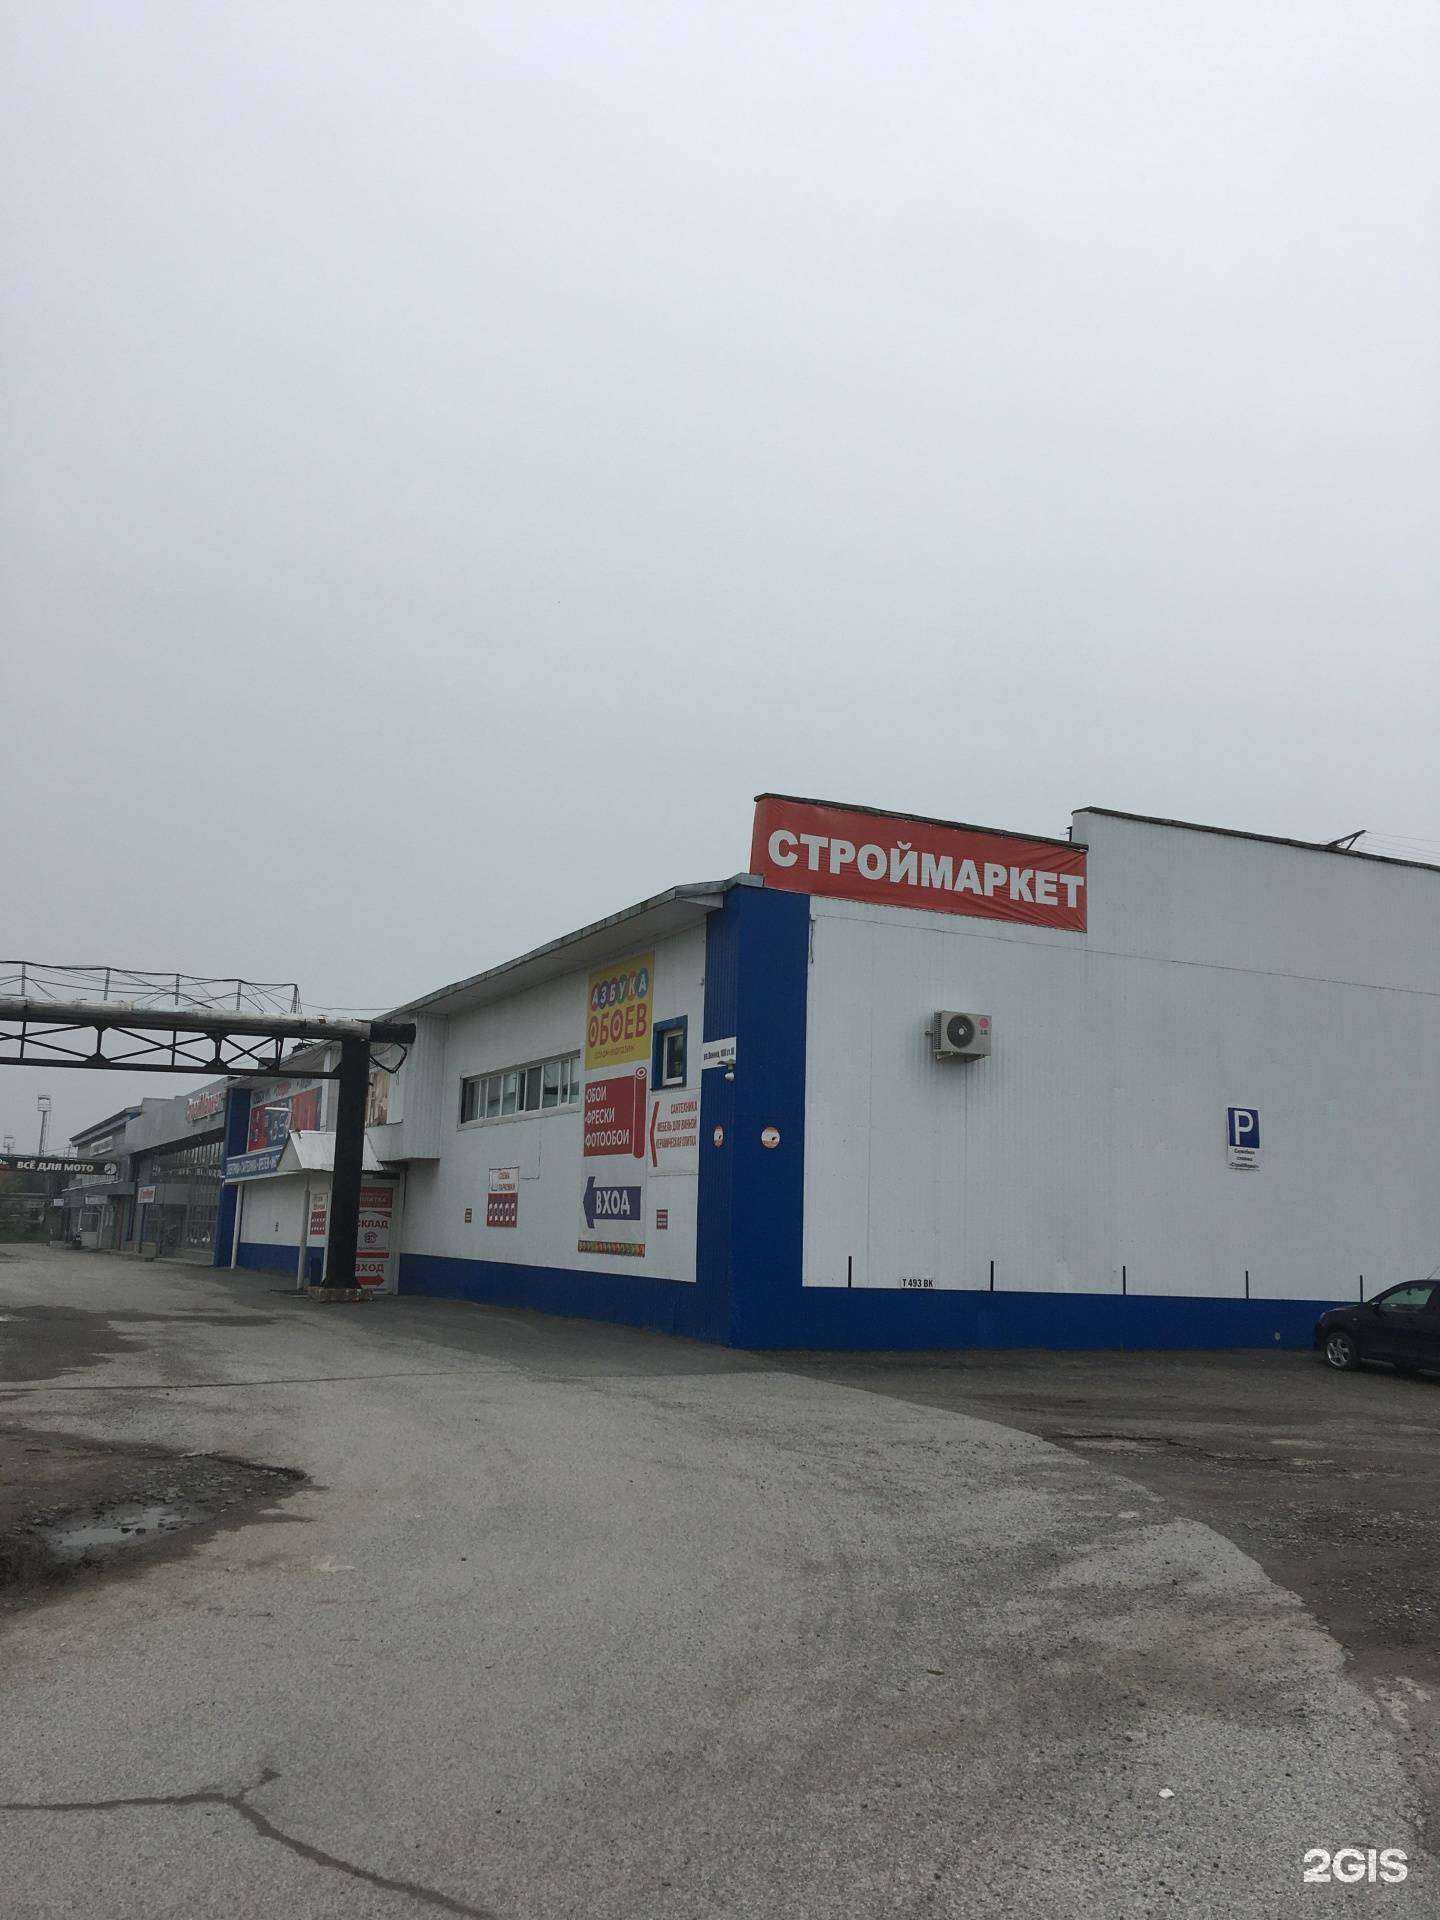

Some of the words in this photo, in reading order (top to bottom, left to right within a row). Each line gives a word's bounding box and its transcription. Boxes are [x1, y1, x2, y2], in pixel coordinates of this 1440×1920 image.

[768, 829, 1085, 908] СТРОЙМАРКЕТ
[591, 970, 649, 1009] АЗБУКА
[588, 1003, 647, 1048] ОБОЕВ
[586, 1086, 607, 1103] ОБОИ
[585, 1107, 615, 1124] ФРЕСКИ
[1234, 1110, 1254, 1145] P
[585, 1129, 630, 1148] ФОТООБОИ
[17, 1160, 36, 1170] ВСЁ
[37, 1161, 62, 1172] ДЛЯ
[64, 1162, 94, 1173] МОТО
[596, 1190, 631, 1215] ВХОД
